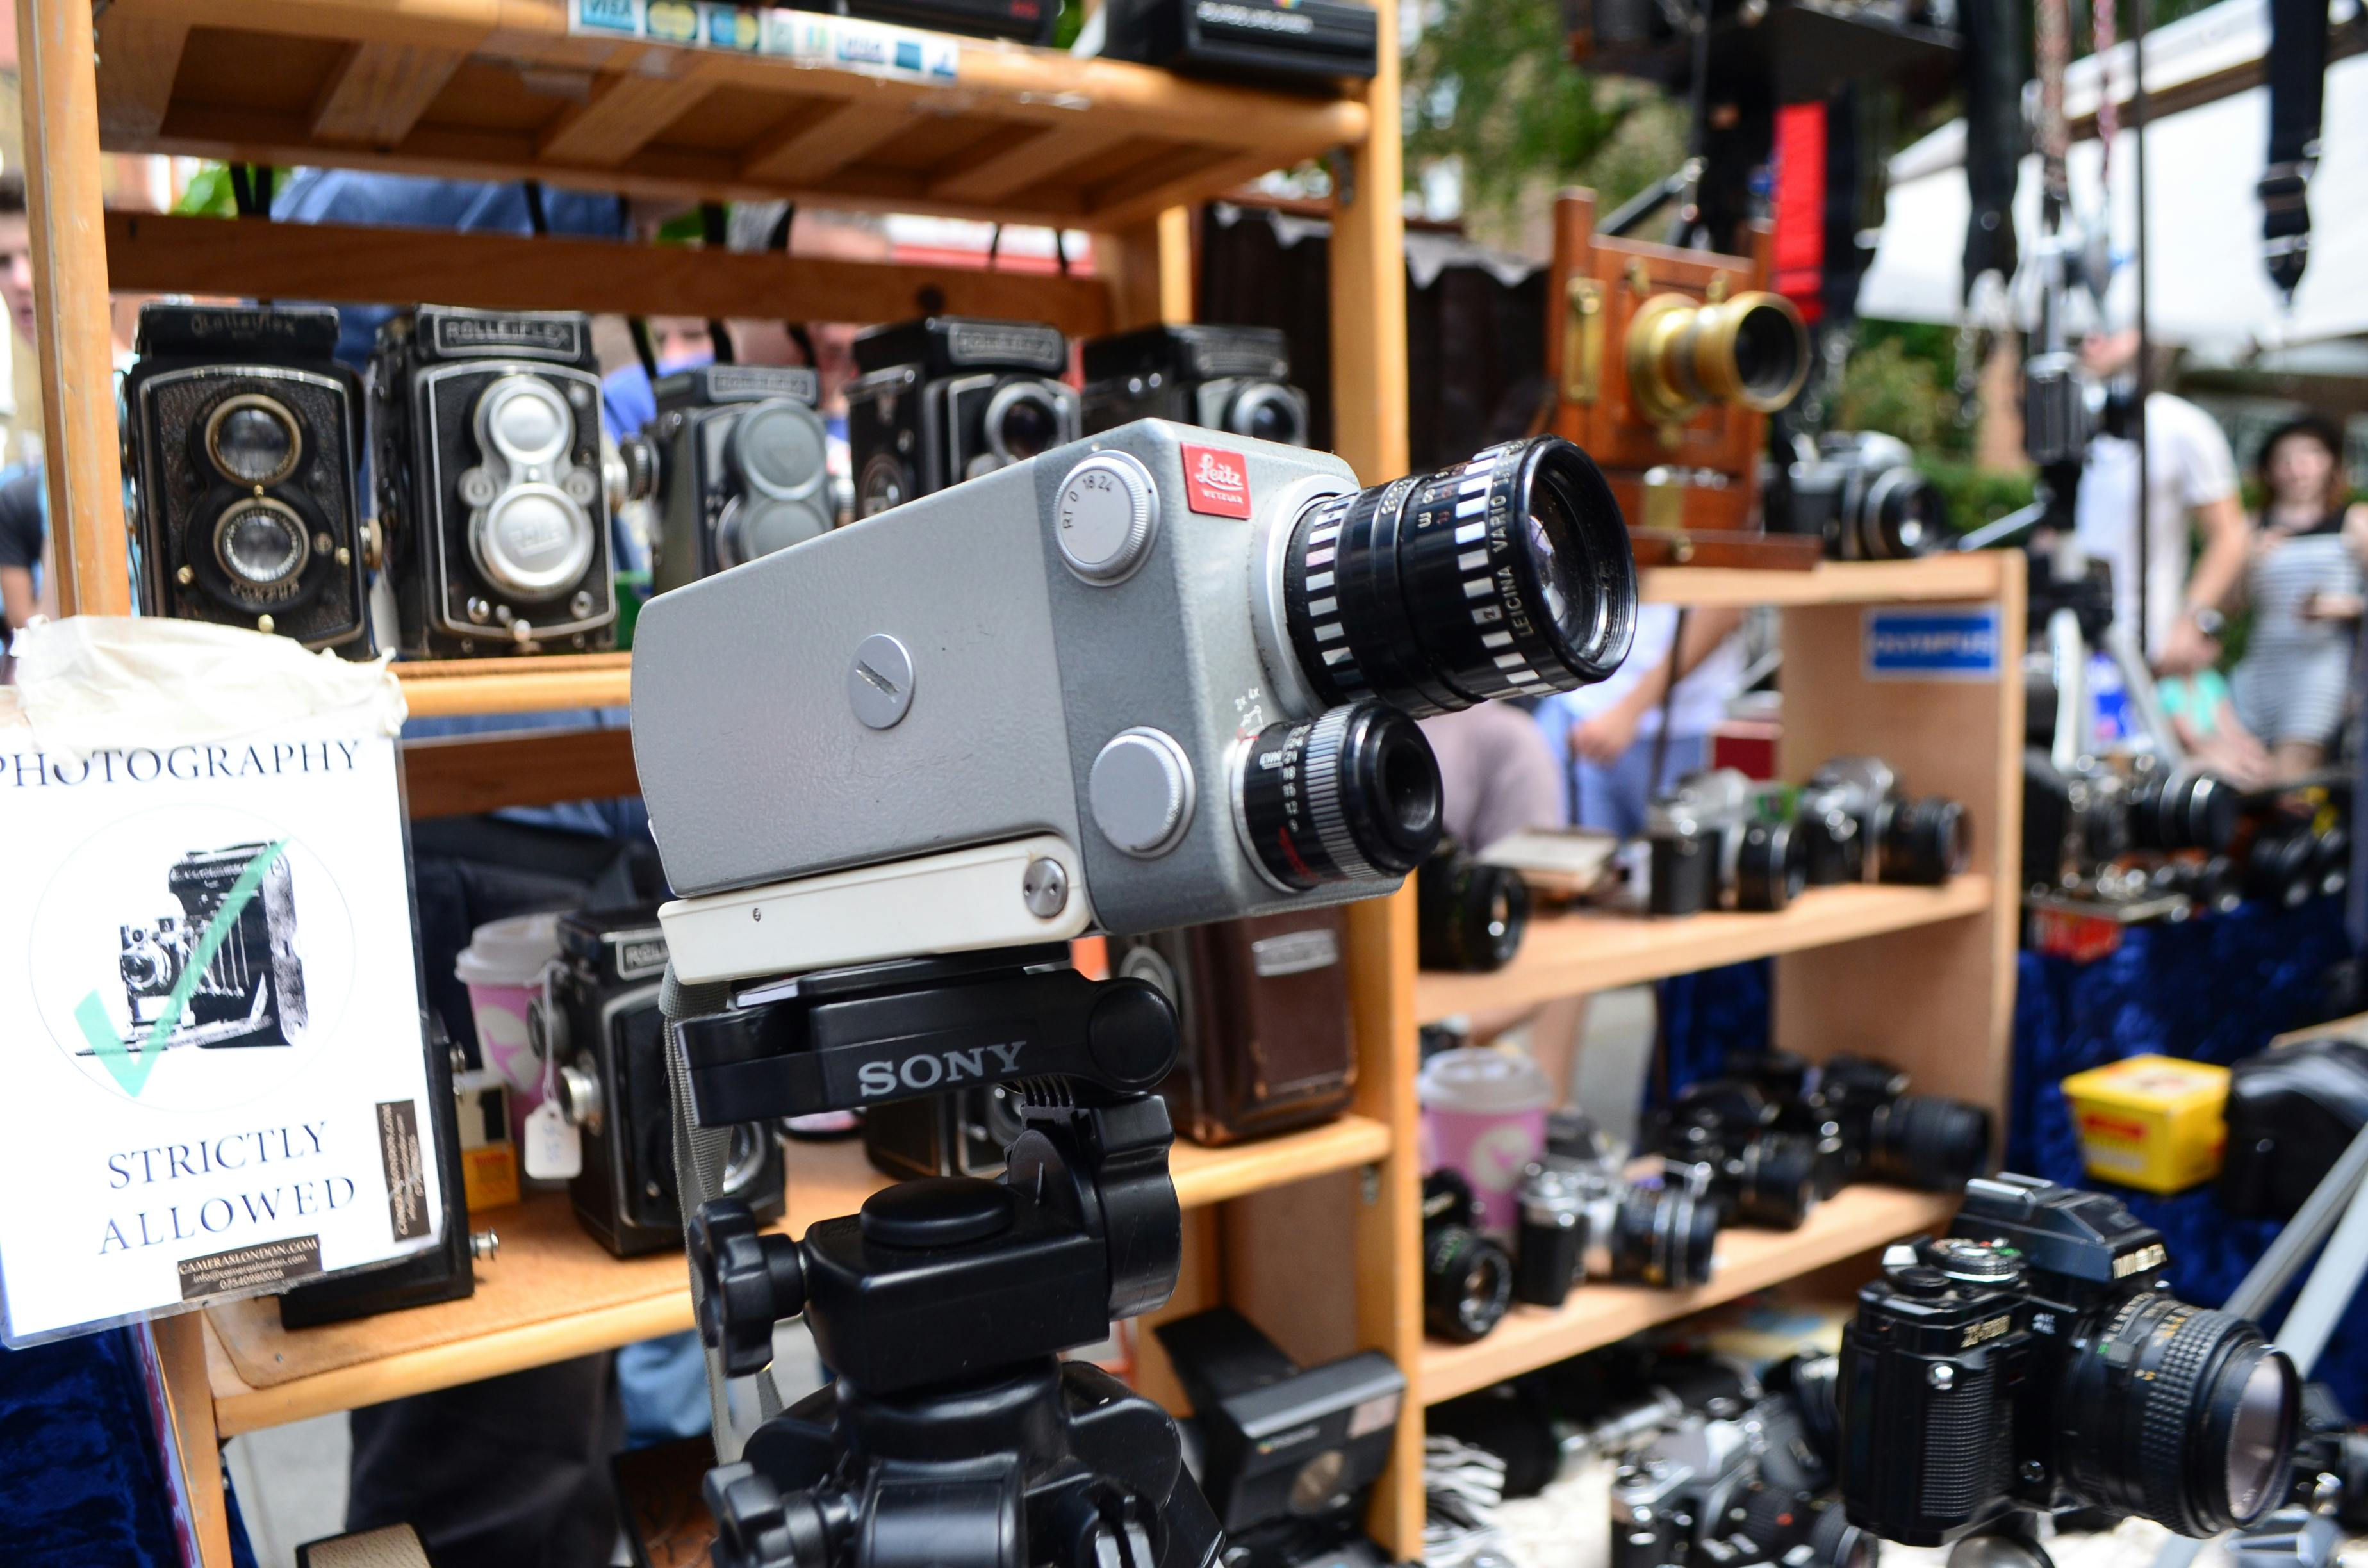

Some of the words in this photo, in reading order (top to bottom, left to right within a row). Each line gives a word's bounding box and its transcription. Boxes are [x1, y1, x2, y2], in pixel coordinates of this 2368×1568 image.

[1194, 452, 1244, 491] Leitz
[1203, 490, 1243, 505] WETZLAR
[1490, 495, 1508, 553] VARIO
[1497, 565, 1534, 637] LEICINA
[857, 1040, 1027, 1097] SONY
[108, 1120, 327, 1189] STRICTLY
[97, 1175, 355, 1255] ALLOWED
[178, 1237, 318, 1275] CAMERASLONDON.COM
